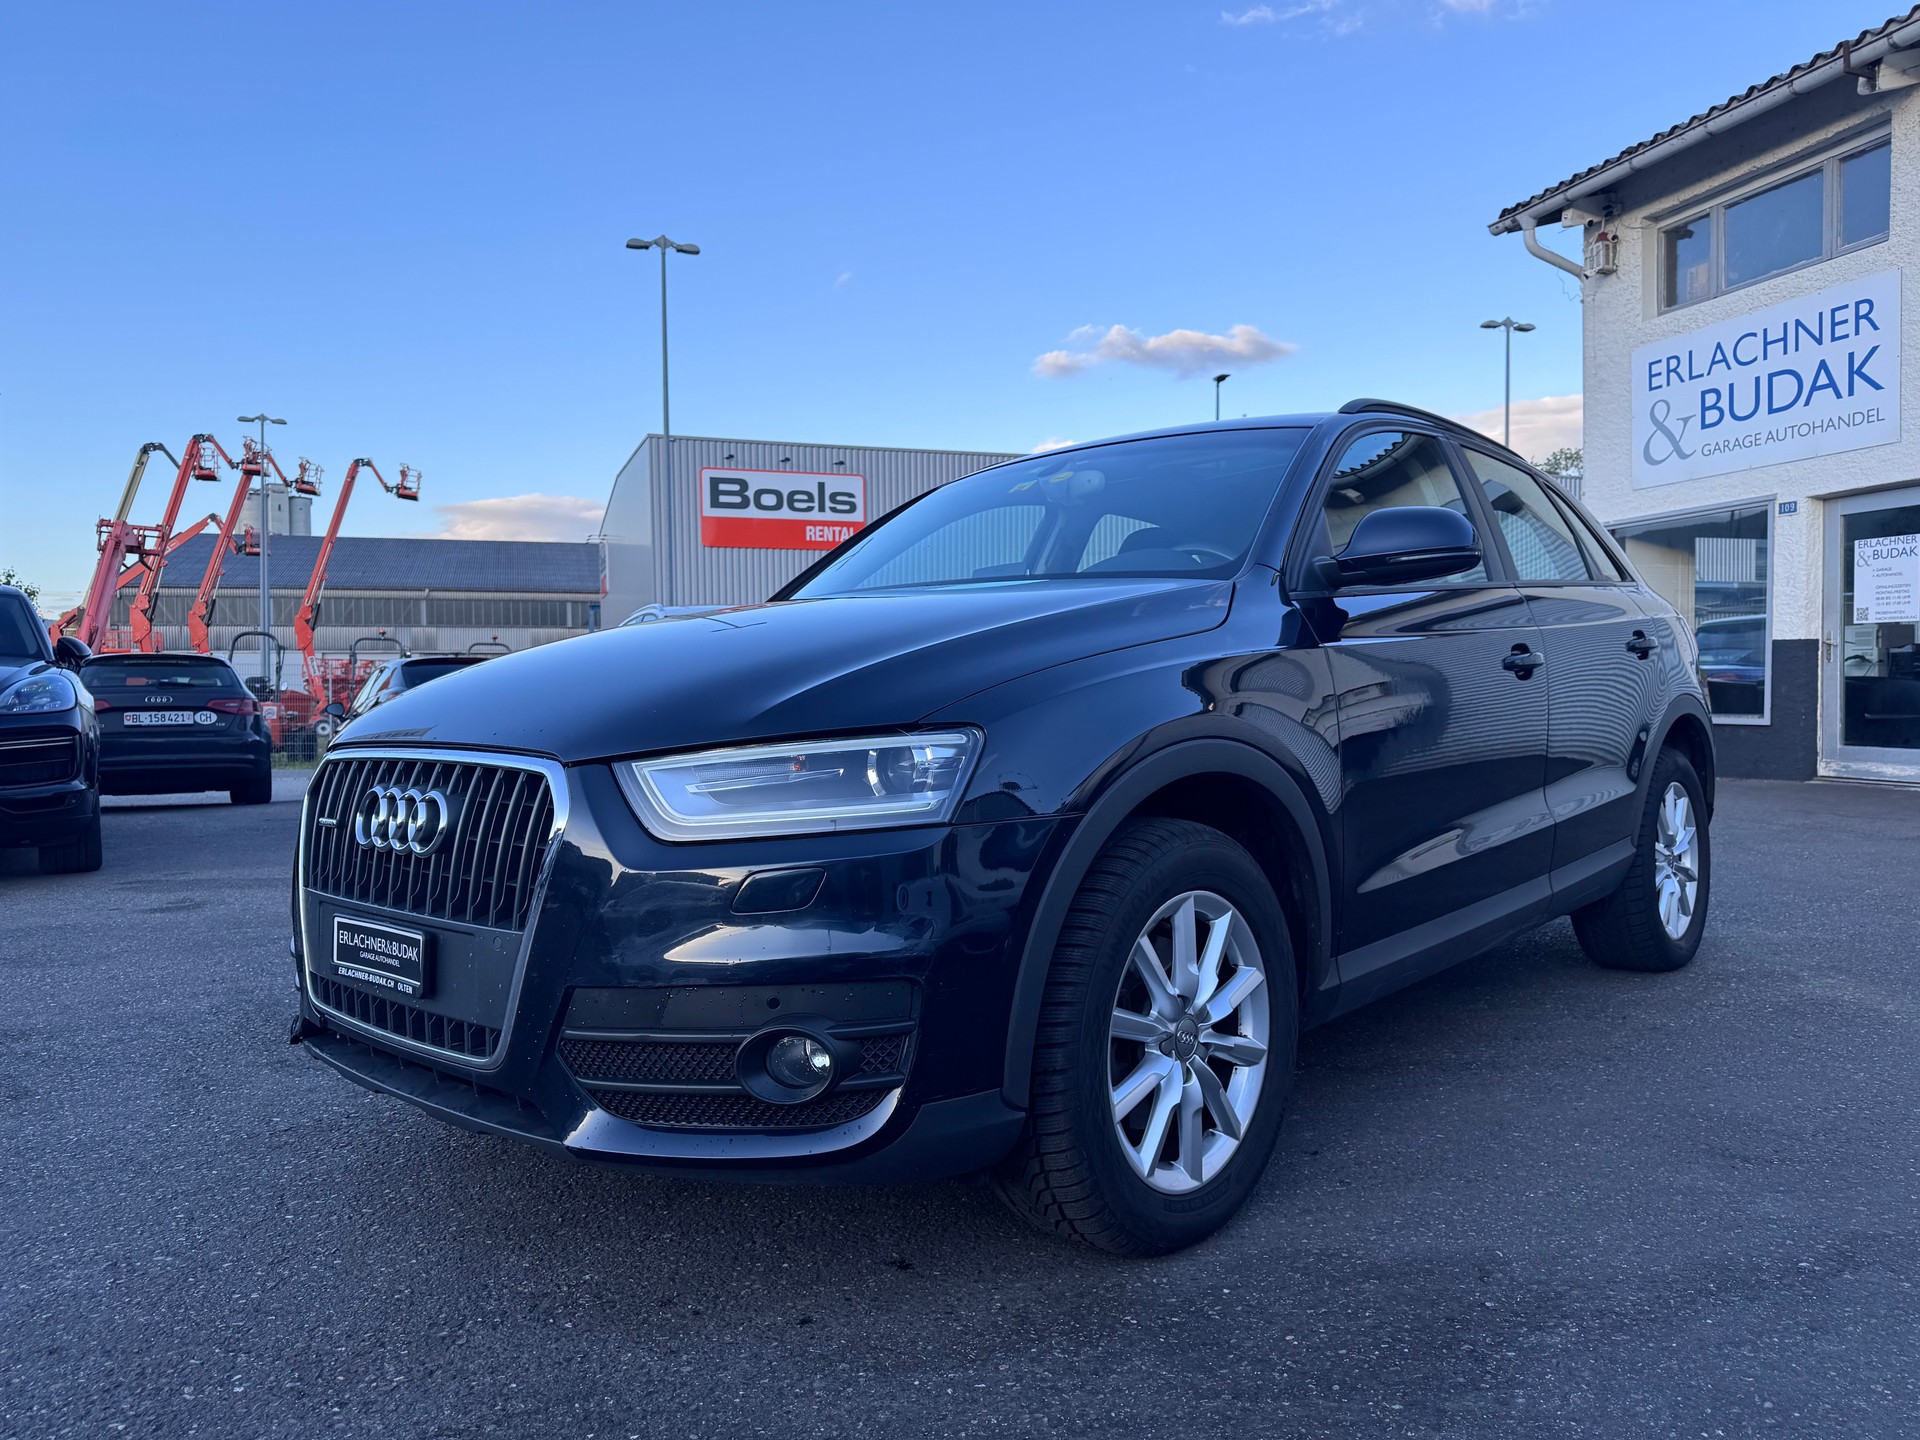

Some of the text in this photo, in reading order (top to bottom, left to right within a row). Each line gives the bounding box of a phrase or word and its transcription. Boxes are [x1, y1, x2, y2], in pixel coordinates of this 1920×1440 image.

[1648, 298, 1880, 392] ERLACHNER
[1701, 407, 1885, 457] GARAGE AUTOHANDEL
[709, 476, 857, 514] Boels
[1780, 503, 1795, 512] 109
[1858, 535, 1918, 549] ERLACHNER
[200, 712, 212, 723] CH
[338, 966, 413, 994] ERLACHNER-BUDAK.CH OLTEN
